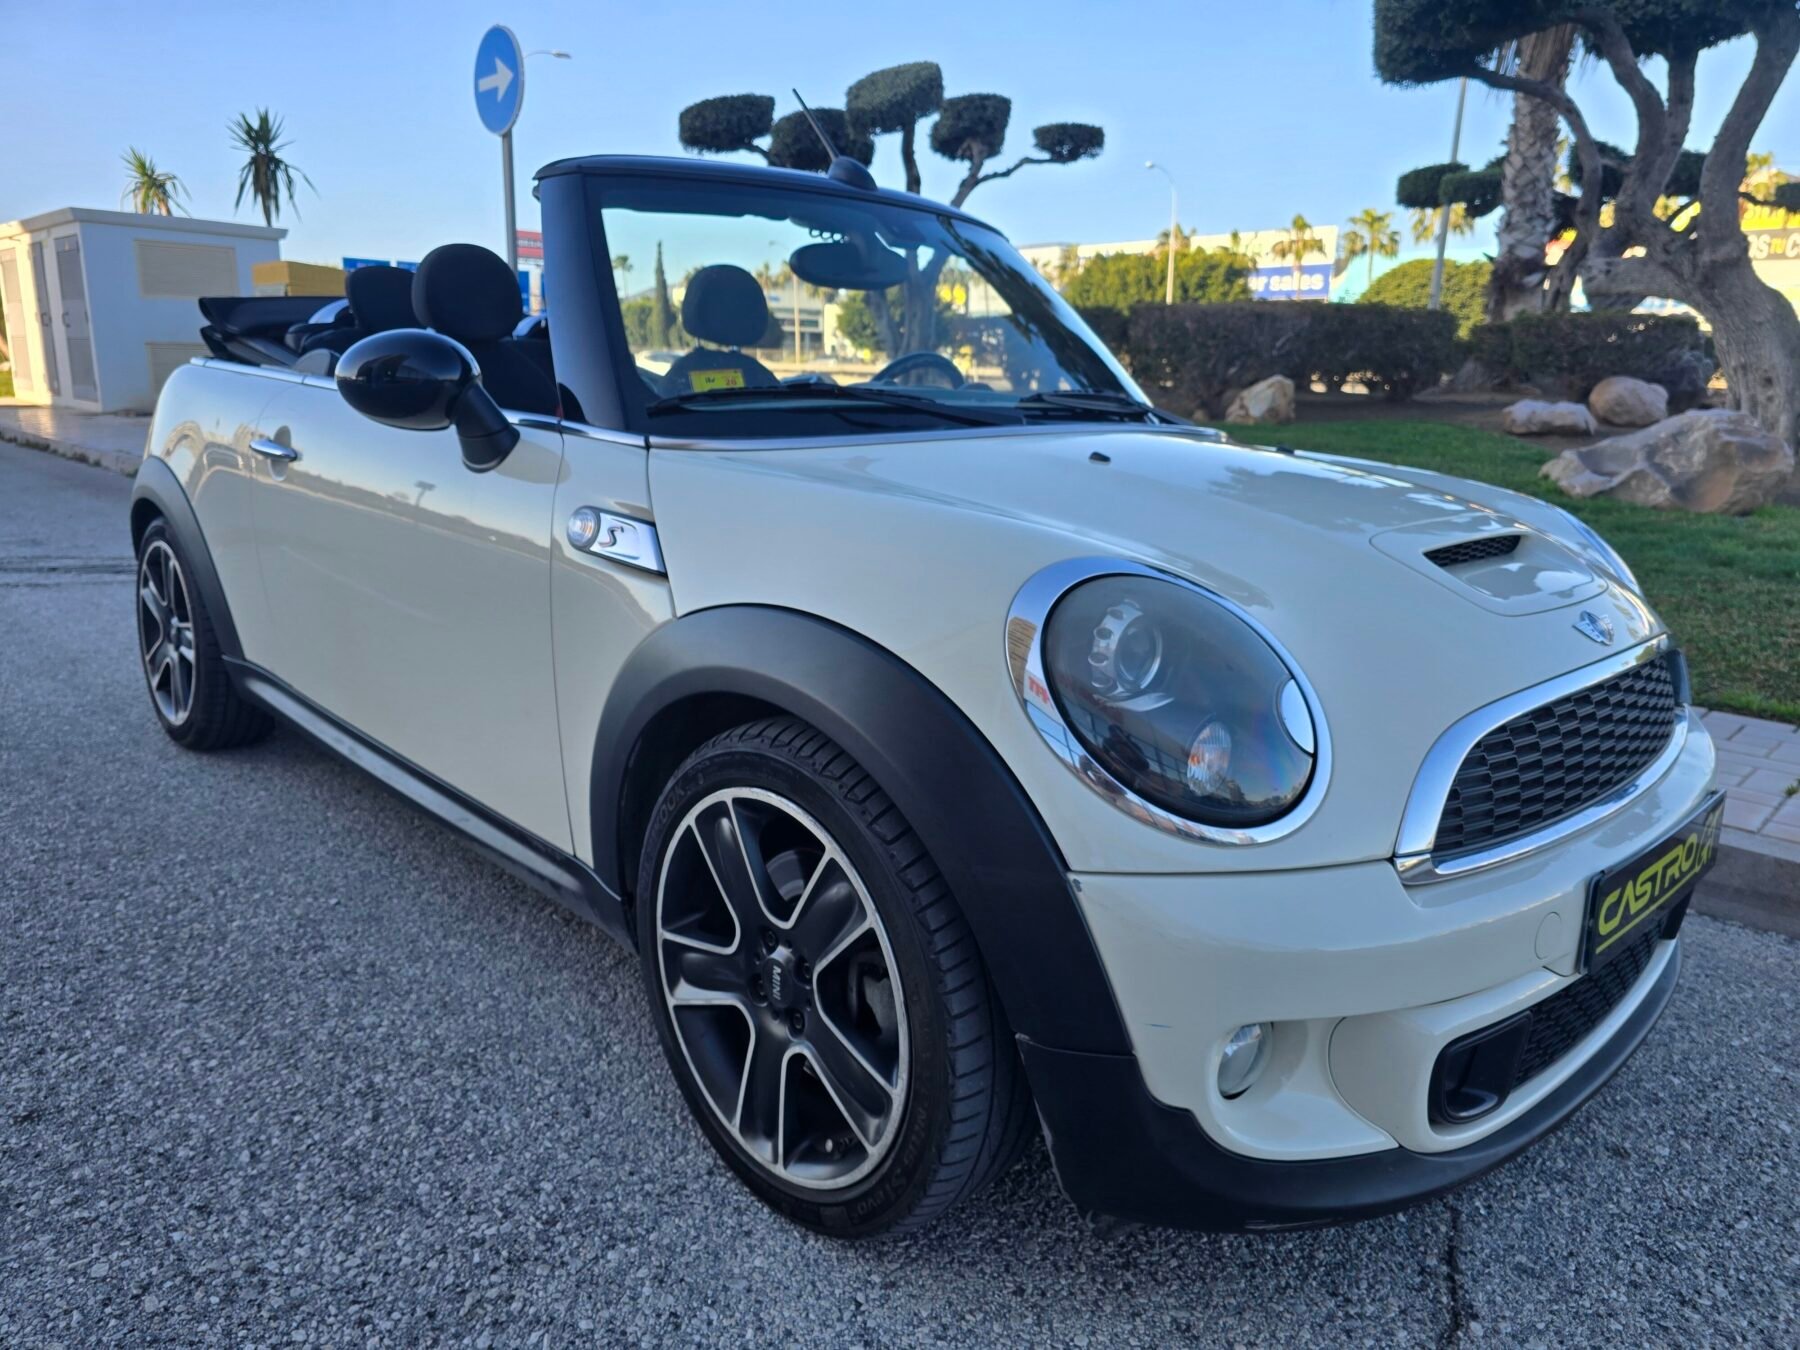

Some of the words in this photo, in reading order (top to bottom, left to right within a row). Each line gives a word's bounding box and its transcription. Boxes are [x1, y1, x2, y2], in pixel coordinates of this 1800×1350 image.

[1269, 272, 1325, 292] sales
[599, 526, 624, 548] S
[1599, 833, 1697, 936] CASTRO
[772, 965, 782, 1000] MINI
